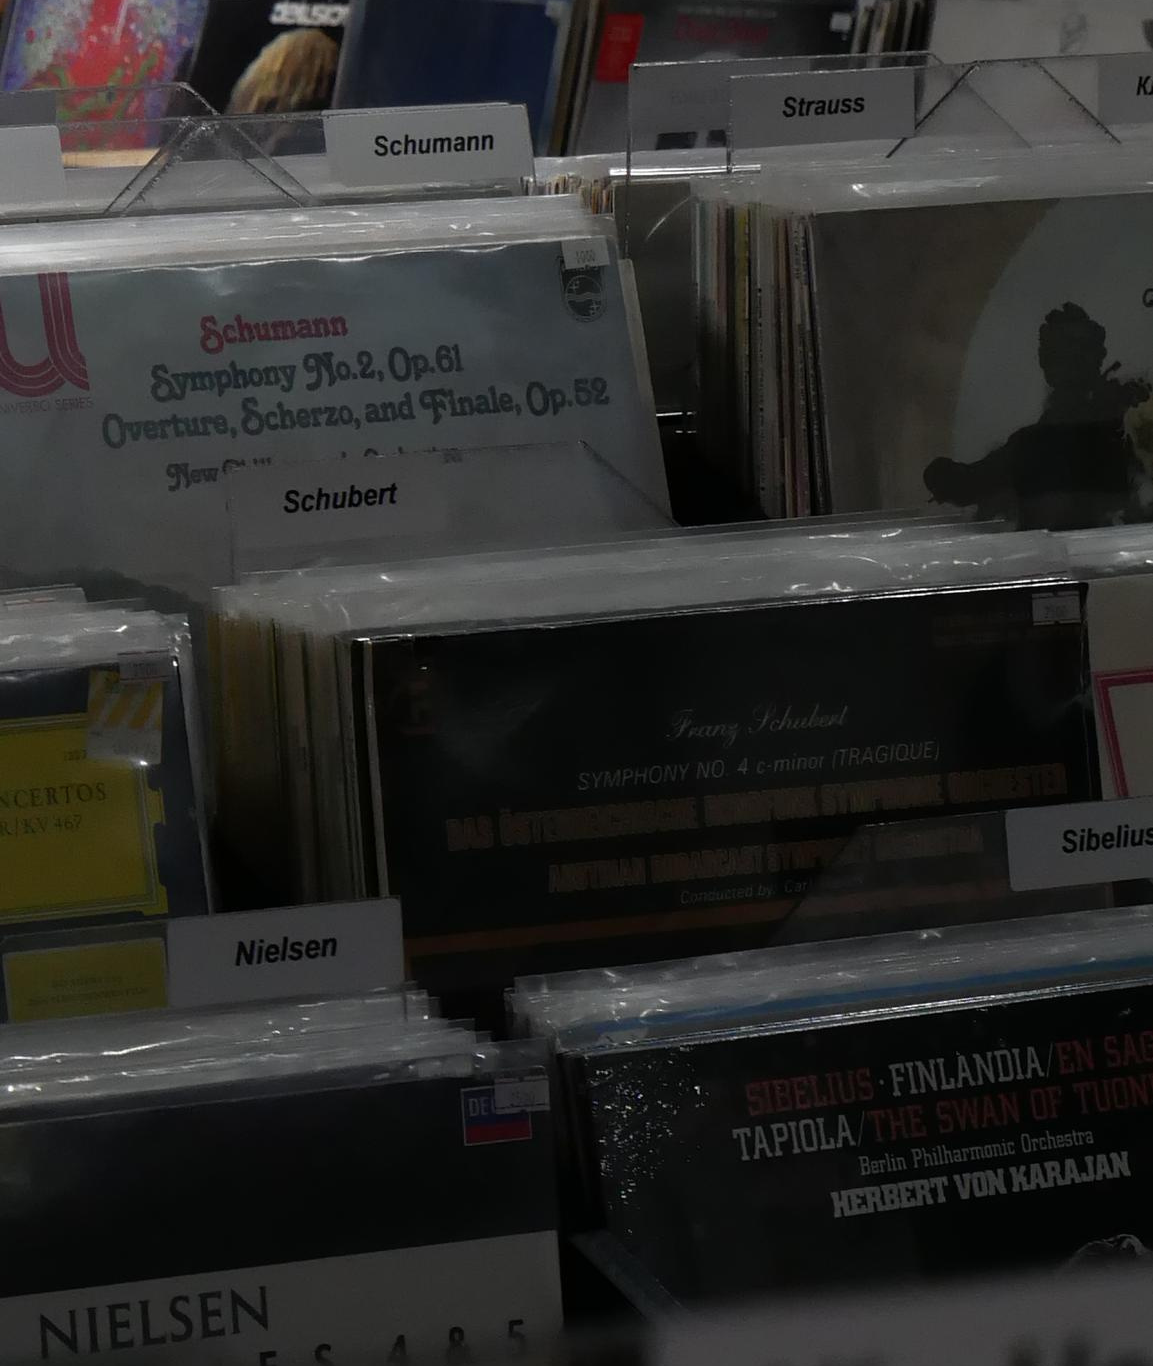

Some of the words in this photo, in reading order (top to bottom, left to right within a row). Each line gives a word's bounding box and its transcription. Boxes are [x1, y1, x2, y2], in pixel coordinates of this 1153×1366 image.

[782, 93, 866, 119] Strauss
[373, 131, 495, 159] Schumann
[199, 314, 348, 354] Schumann
[150, 359, 297, 403] Symphony
[388, 344, 465, 382] Op.61
[55, 396, 95, 411] SERIES
[102, 410, 237, 449] Overture,
[240, 396, 361, 436] Scherzo,
[365, 392, 414, 424] and
[419, 385, 522, 426] Finale,
[525, 377, 611, 416] Op.52
[166, 462, 219, 492] New
[283, 483, 398, 513] Schubert
[664, 708, 739, 748] Franz
[747, 703, 849, 736] Schubert
[577, 762, 690, 791] SYMPHONY
[696, 759, 728, 779] NO.
[737, 757, 749, 775] 4
[756, 754, 826, 775] c-minor
[831, 740, 941, 771] (TRAGIQUE)
[1061, 824, 1153, 853] Sibelius
[679, 884, 753, 905] Conducted
[233, 935, 337, 971] Nielsen
[746, 1067, 874, 1117] SIBELIUS
[937, 1092, 1021, 1134] SWAN
[1030, 1085, 1063, 1120] OF
[859, 1152, 906, 1176] Berlin
[912, 1137, 1016, 1172] Philharmonic
[1021, 1128, 1095, 1155] Orchestra
[830, 1178, 948, 1218] HERBERT
[956, 1168, 1005, 1201] VON
[1011, 1151, 1132, 1193] KARAJAN
[40, 1285, 270, 1359] NIELSEN
[506, 1318, 526, 1357] 5
